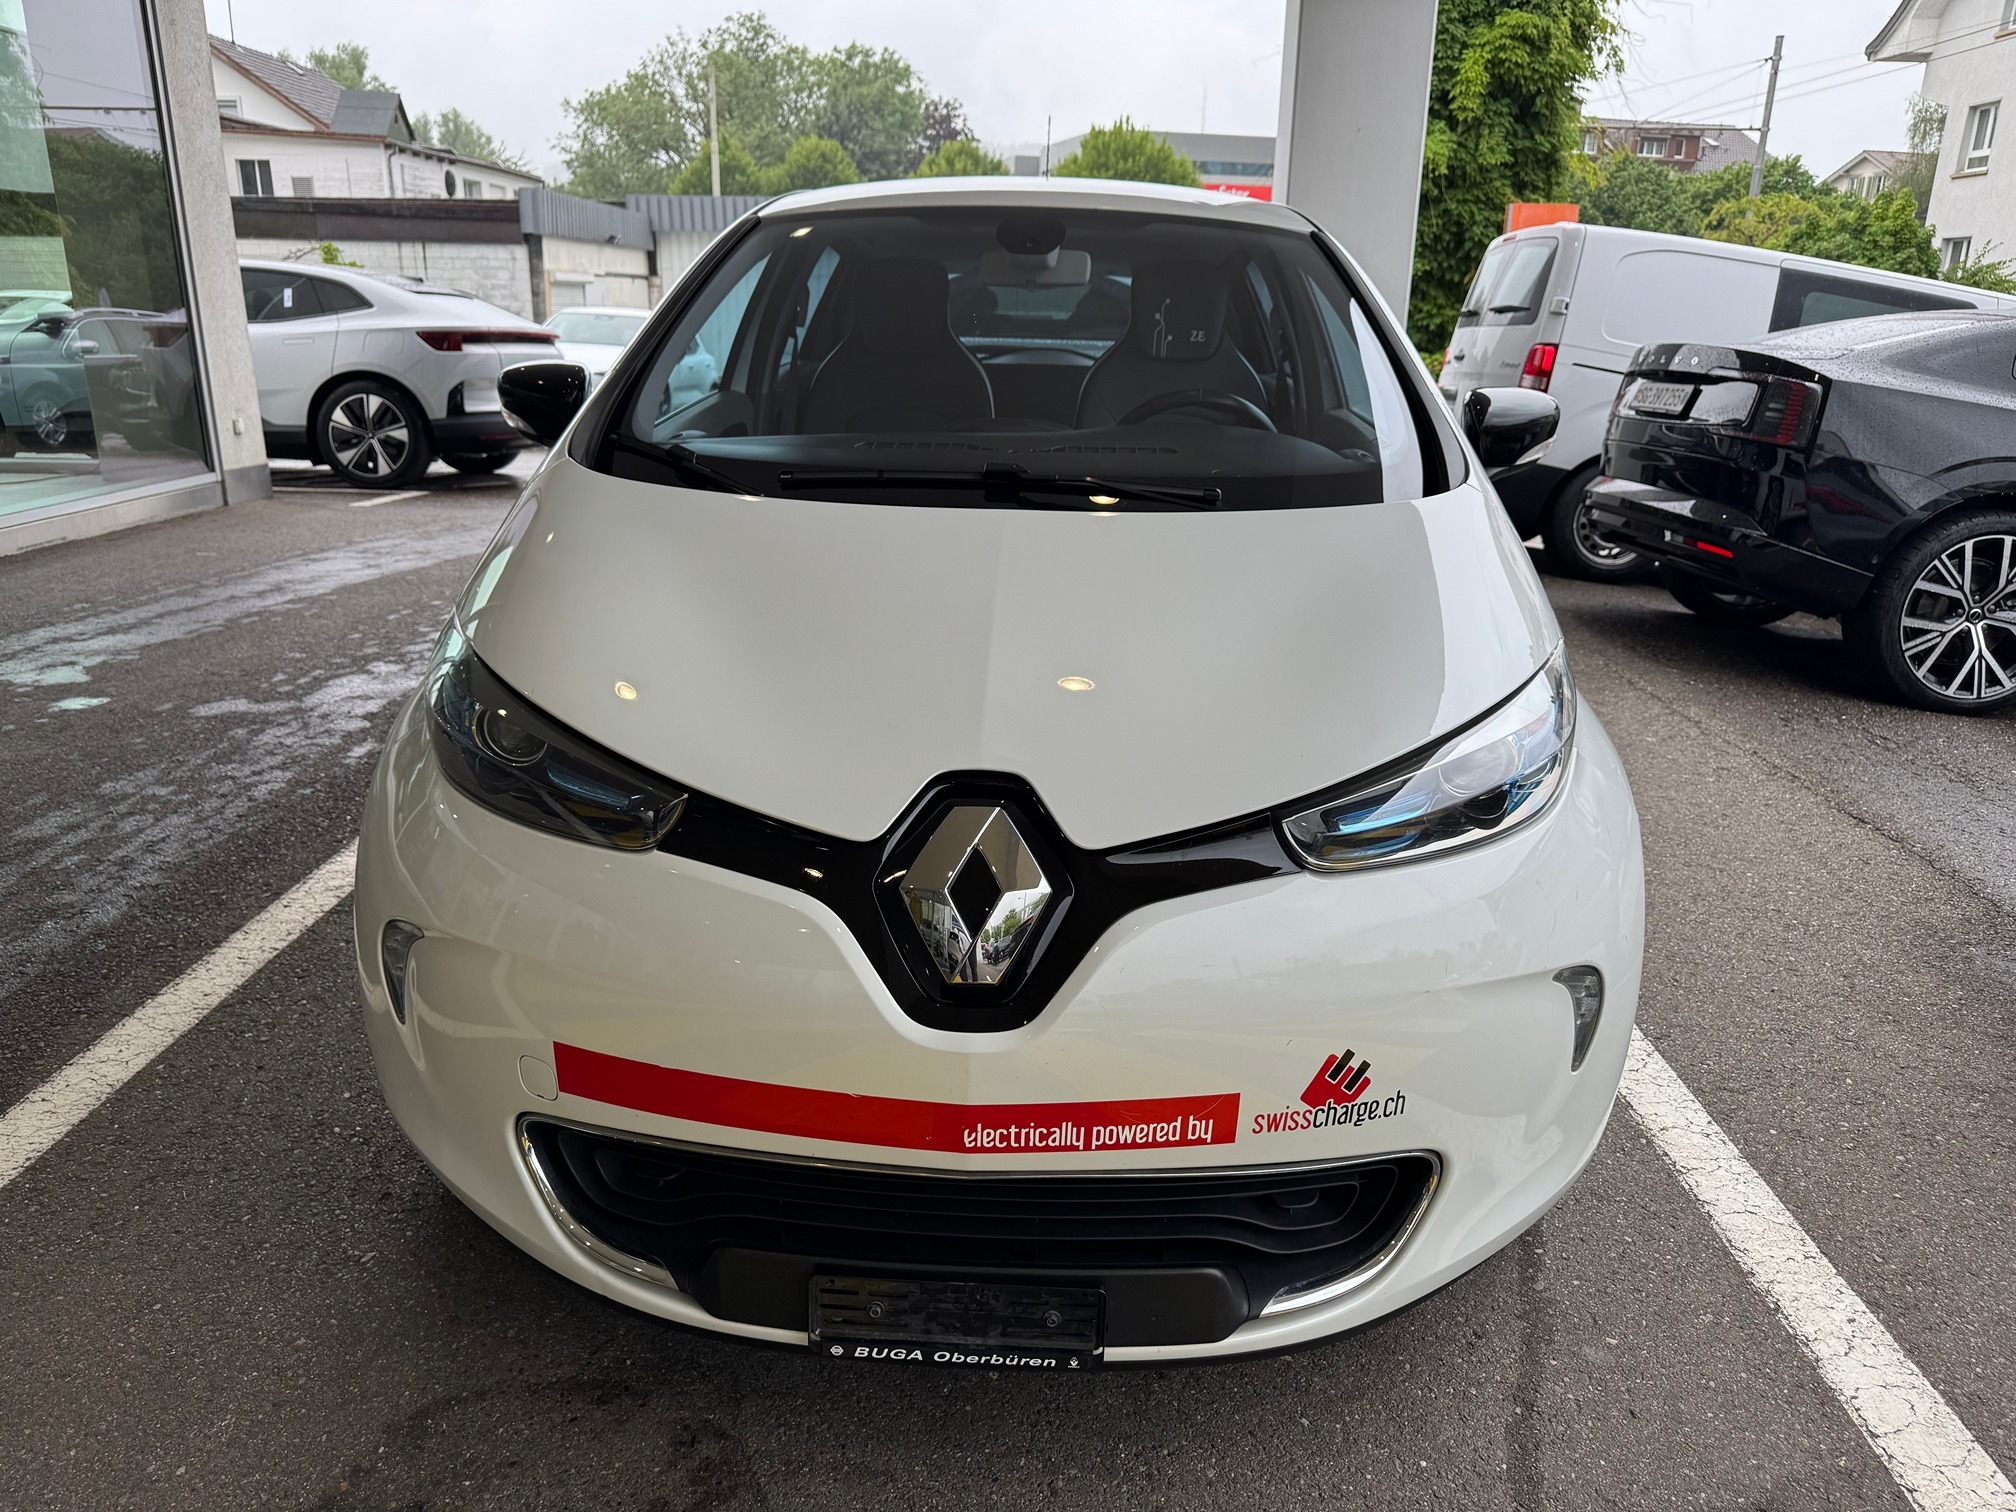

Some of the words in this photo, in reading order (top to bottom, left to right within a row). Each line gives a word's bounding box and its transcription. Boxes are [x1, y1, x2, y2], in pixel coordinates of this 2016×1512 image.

[1190, 330, 1206, 342] ZE
[1637, 355, 1700, 366] VOLVO
[1252, 1089, 1407, 1135] swisscharge.ch
[963, 1117, 1085, 1150] electrically
[1091, 1116, 1182, 1150] powered
[1186, 1116, 1214, 1143] by
[853, 1346, 924, 1361] BUGA
[933, 1351, 1057, 1368] Oberbüren
